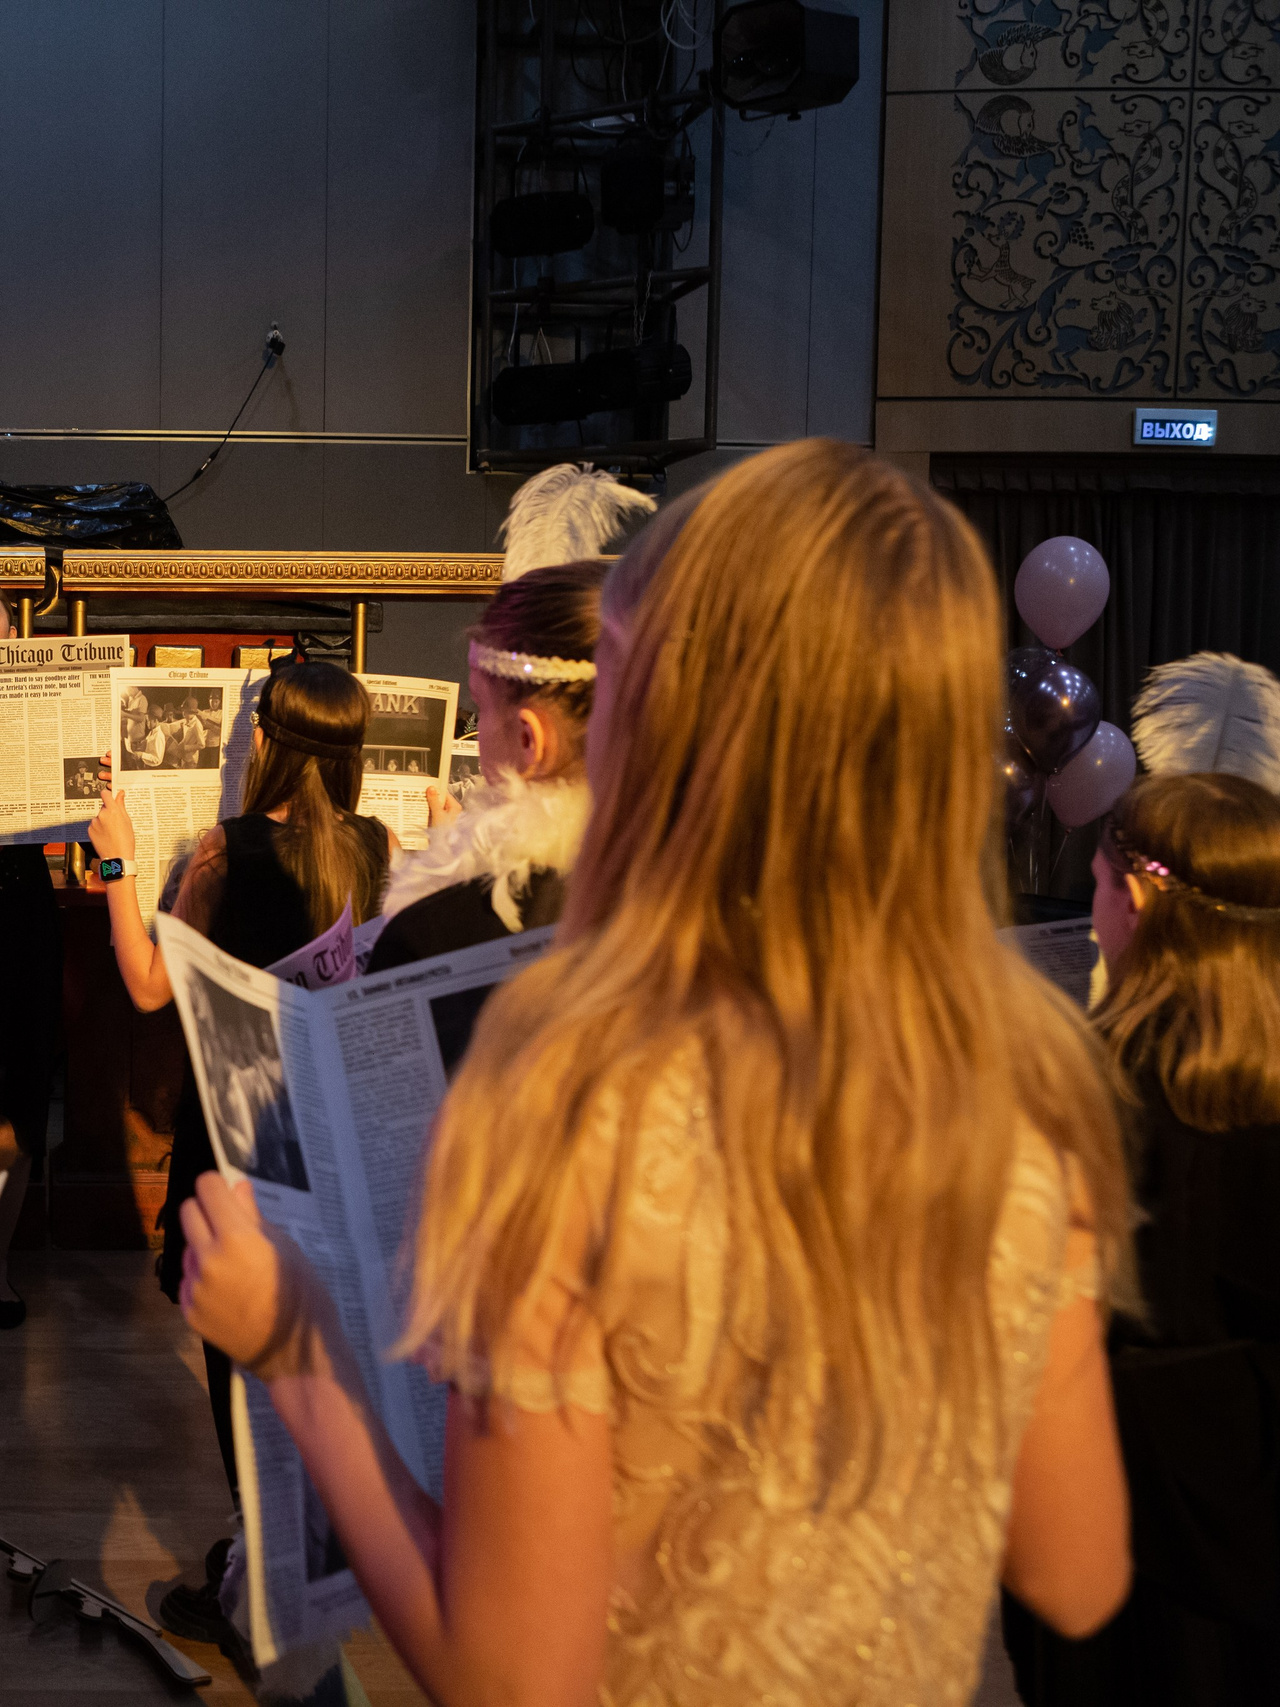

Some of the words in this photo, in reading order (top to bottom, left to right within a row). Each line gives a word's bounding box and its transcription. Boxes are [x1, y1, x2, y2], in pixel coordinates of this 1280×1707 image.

[1142, 422, 1210, 441] ВЫХОД
[60, 642, 124, 662] Tribune
[168, 671, 188, 680] Chicago
[189, 671, 209, 679] Tribune
[372, 693, 420, 714] ANK
